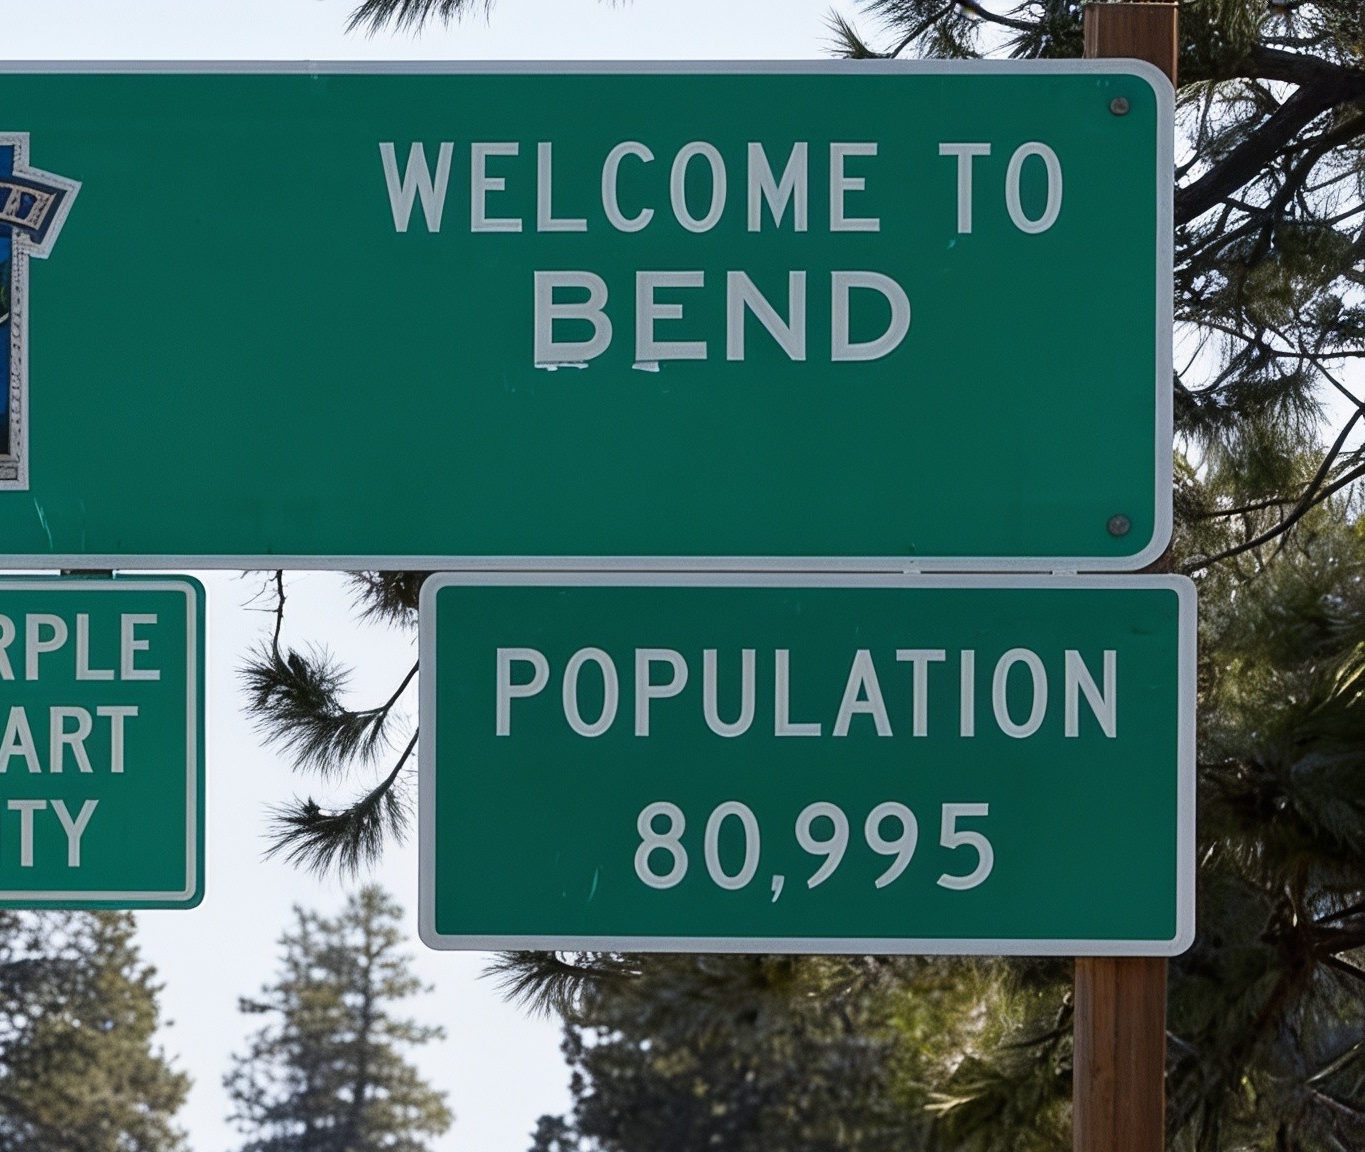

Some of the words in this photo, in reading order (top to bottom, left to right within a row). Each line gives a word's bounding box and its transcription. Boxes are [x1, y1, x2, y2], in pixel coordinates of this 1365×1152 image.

[378, 140, 881, 233] WELCOME
[938, 141, 1063, 235] TO
[533, 270, 912, 364] BEND
[495, 647, 1117, 739] POPULATION
[633, 800, 994, 903] 80,995
